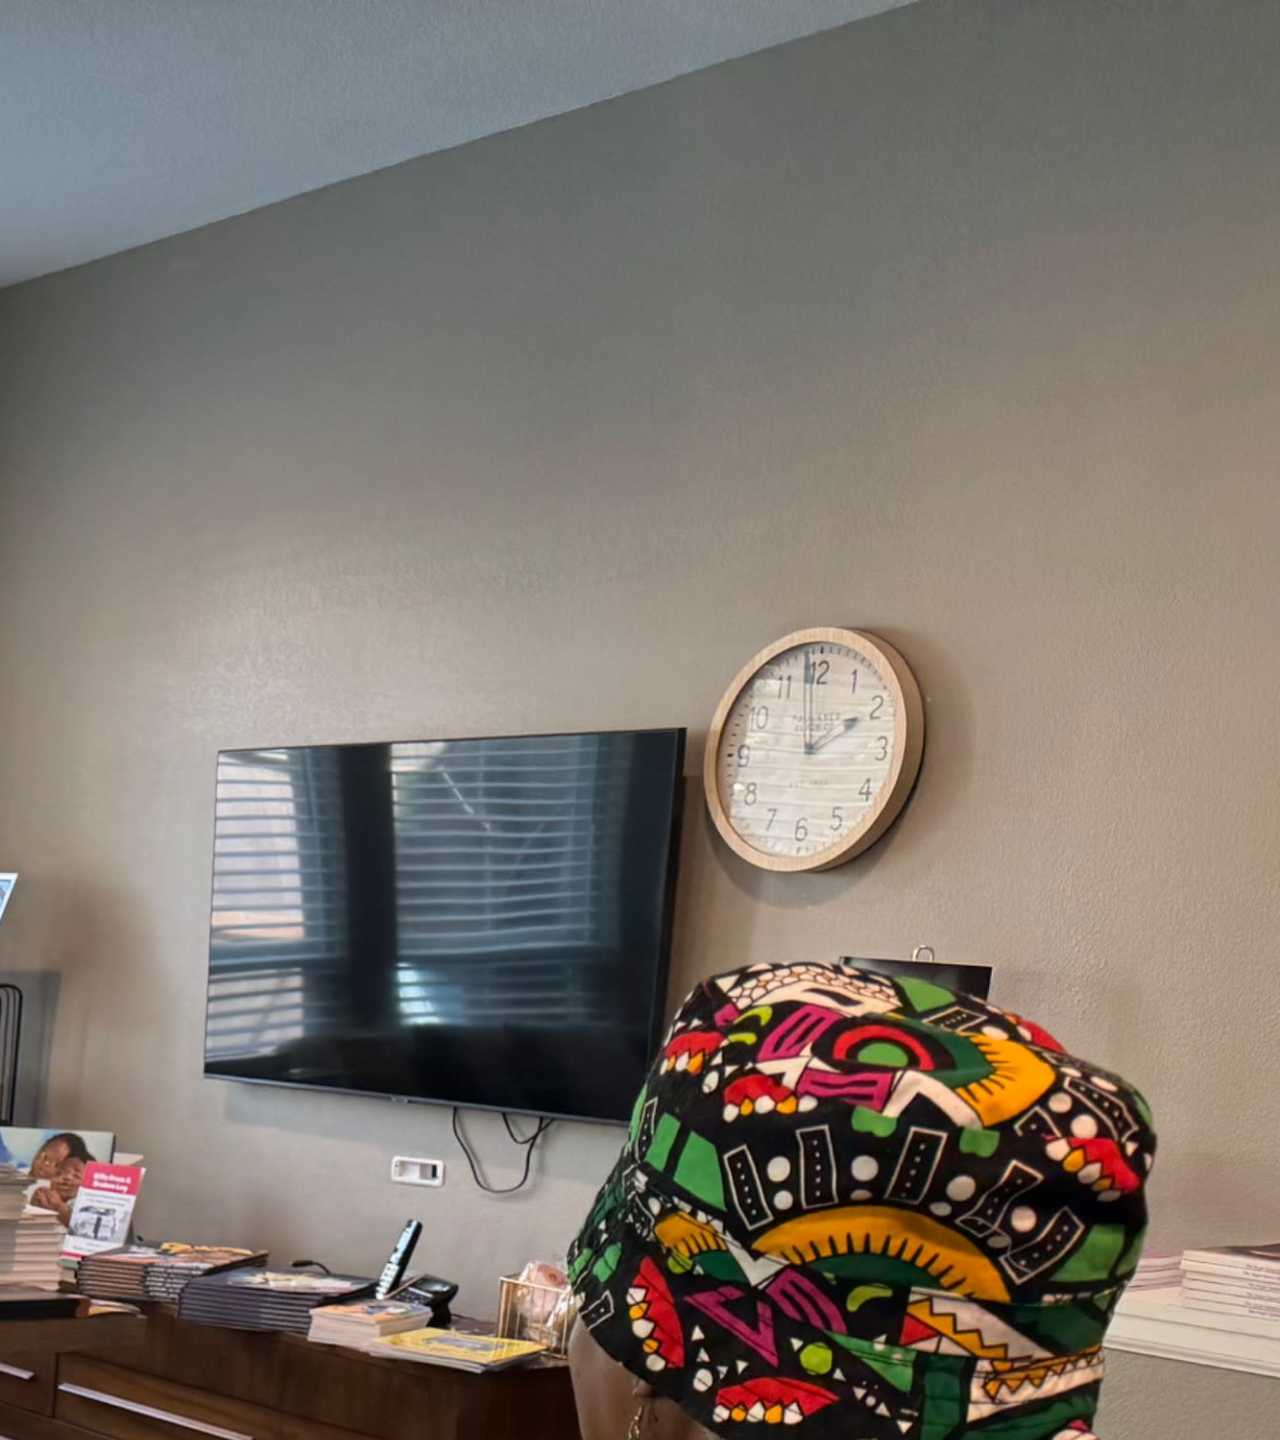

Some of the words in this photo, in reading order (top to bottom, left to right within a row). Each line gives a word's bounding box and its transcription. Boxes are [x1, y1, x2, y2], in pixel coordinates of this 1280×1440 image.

[811, 660, 830, 685] 12
[851, 669, 858, 694] 1
[778, 675, 791, 699] 11
[751, 705, 768, 730] 10
[869, 695, 884, 720] 2
[737, 744, 751, 768] 9
[875, 736, 888, 761] 3
[744, 782, 757, 806] 8
[858, 778, 872, 802] 4
[767, 808, 777, 832] 7
[794, 817, 808, 842] 6
[829, 806, 842, 832] 5
